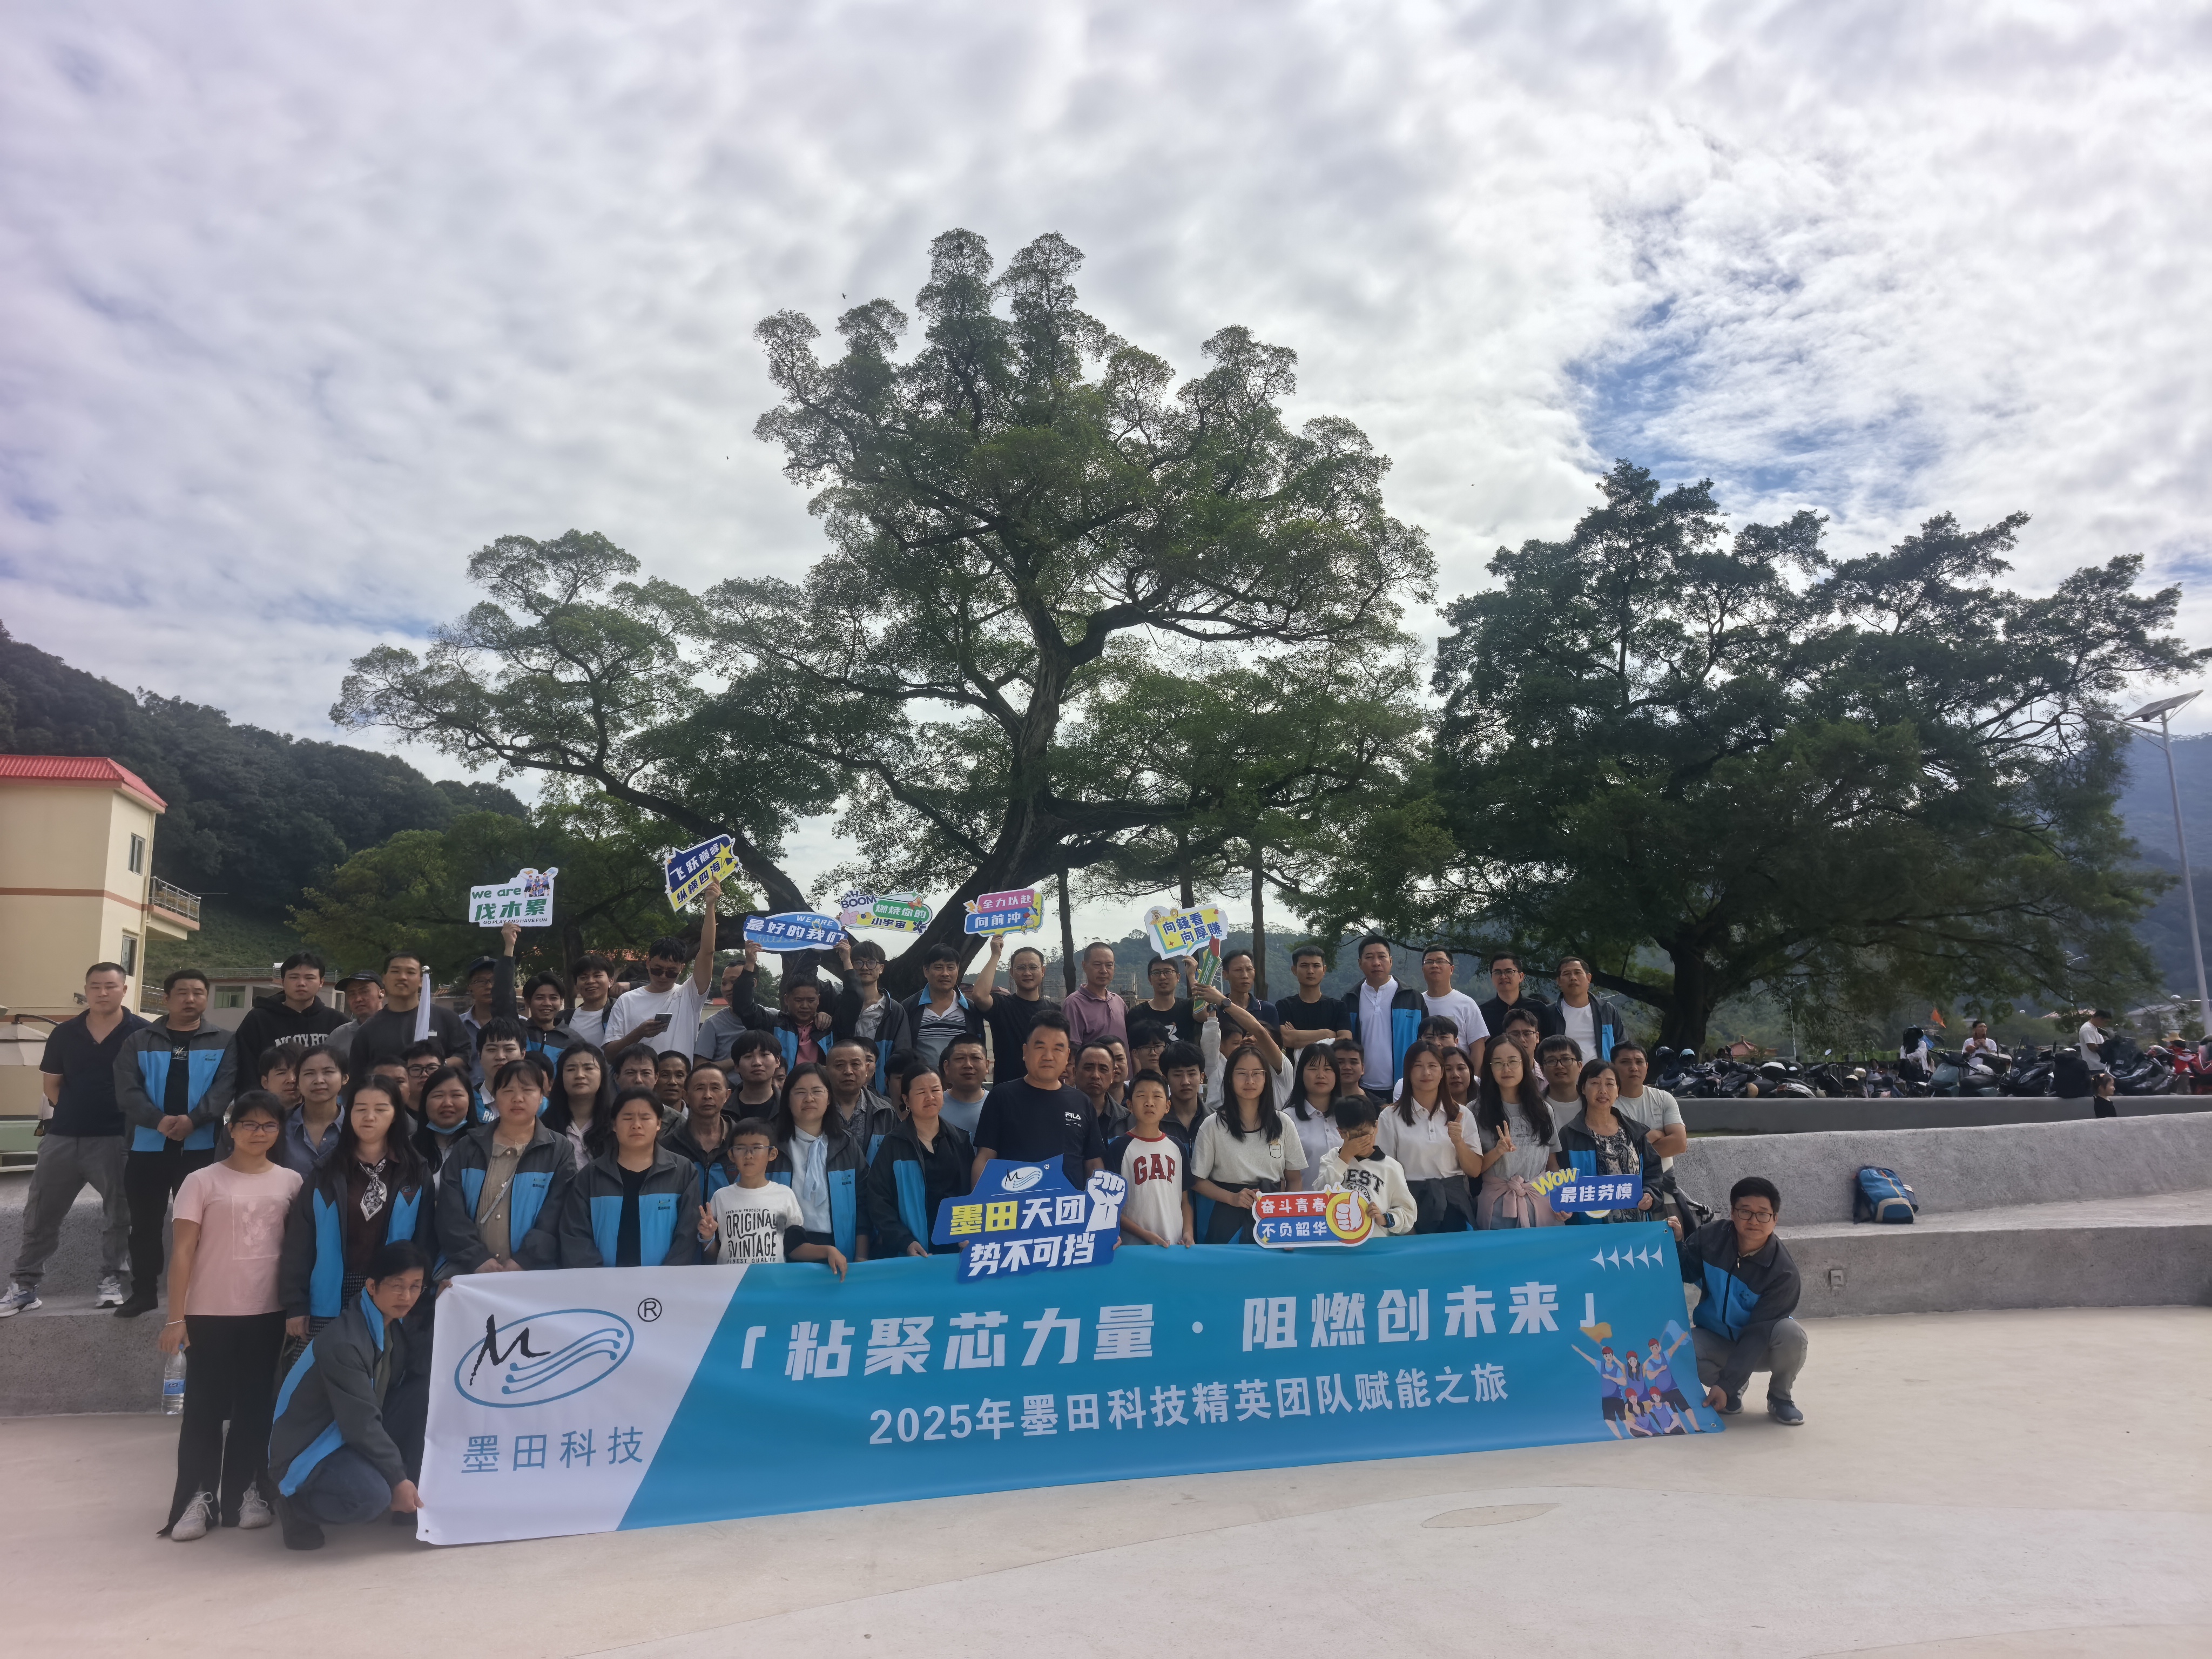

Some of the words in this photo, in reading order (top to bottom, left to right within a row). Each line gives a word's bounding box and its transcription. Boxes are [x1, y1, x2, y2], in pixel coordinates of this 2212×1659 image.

[670, 843, 720, 881] 飞跃巅峰
[471, 890, 492, 899] we
[497, 887, 522, 897] are
[677, 861, 720, 903] 纵横四海
[475, 898, 547, 921] 伐木累
[840, 895, 877, 909] BOOM
[875, 904, 927, 919] 燃烧你的
[982, 895, 1031, 909] 全力以赴
[745, 918, 846, 944] 最好的我们
[813, 918, 834, 926] ARE
[871, 918, 907, 929] 小宇宙
[975, 912, 1021, 928] 向前冲
[1162, 912, 1204, 935] 向錢看
[1065, 1112, 1081, 1121] FILA
[1133, 1154, 1176, 1185] GAP
[1341, 1169, 1385, 1195] EST
[1531, 1167, 1578, 1196] WOW
[1560, 1183, 1633, 1203] 最佳劳模
[949, 1194, 1085, 1236] 墨田天团
[1260, 1197, 1327, 1213] 奋斗青春
[726, 1209, 777, 1239] ORIGINAL
[1262, 1221, 1327, 1238] 不负韶华
[729, 1231, 777, 1258] VINTAGE
[967, 1232, 1095, 1277] 势不可挡
[869, 1362, 1508, 1445] 2025年墨田科技精英团队赋能之旅
[461, 1426, 644, 1474] 墨田科技
